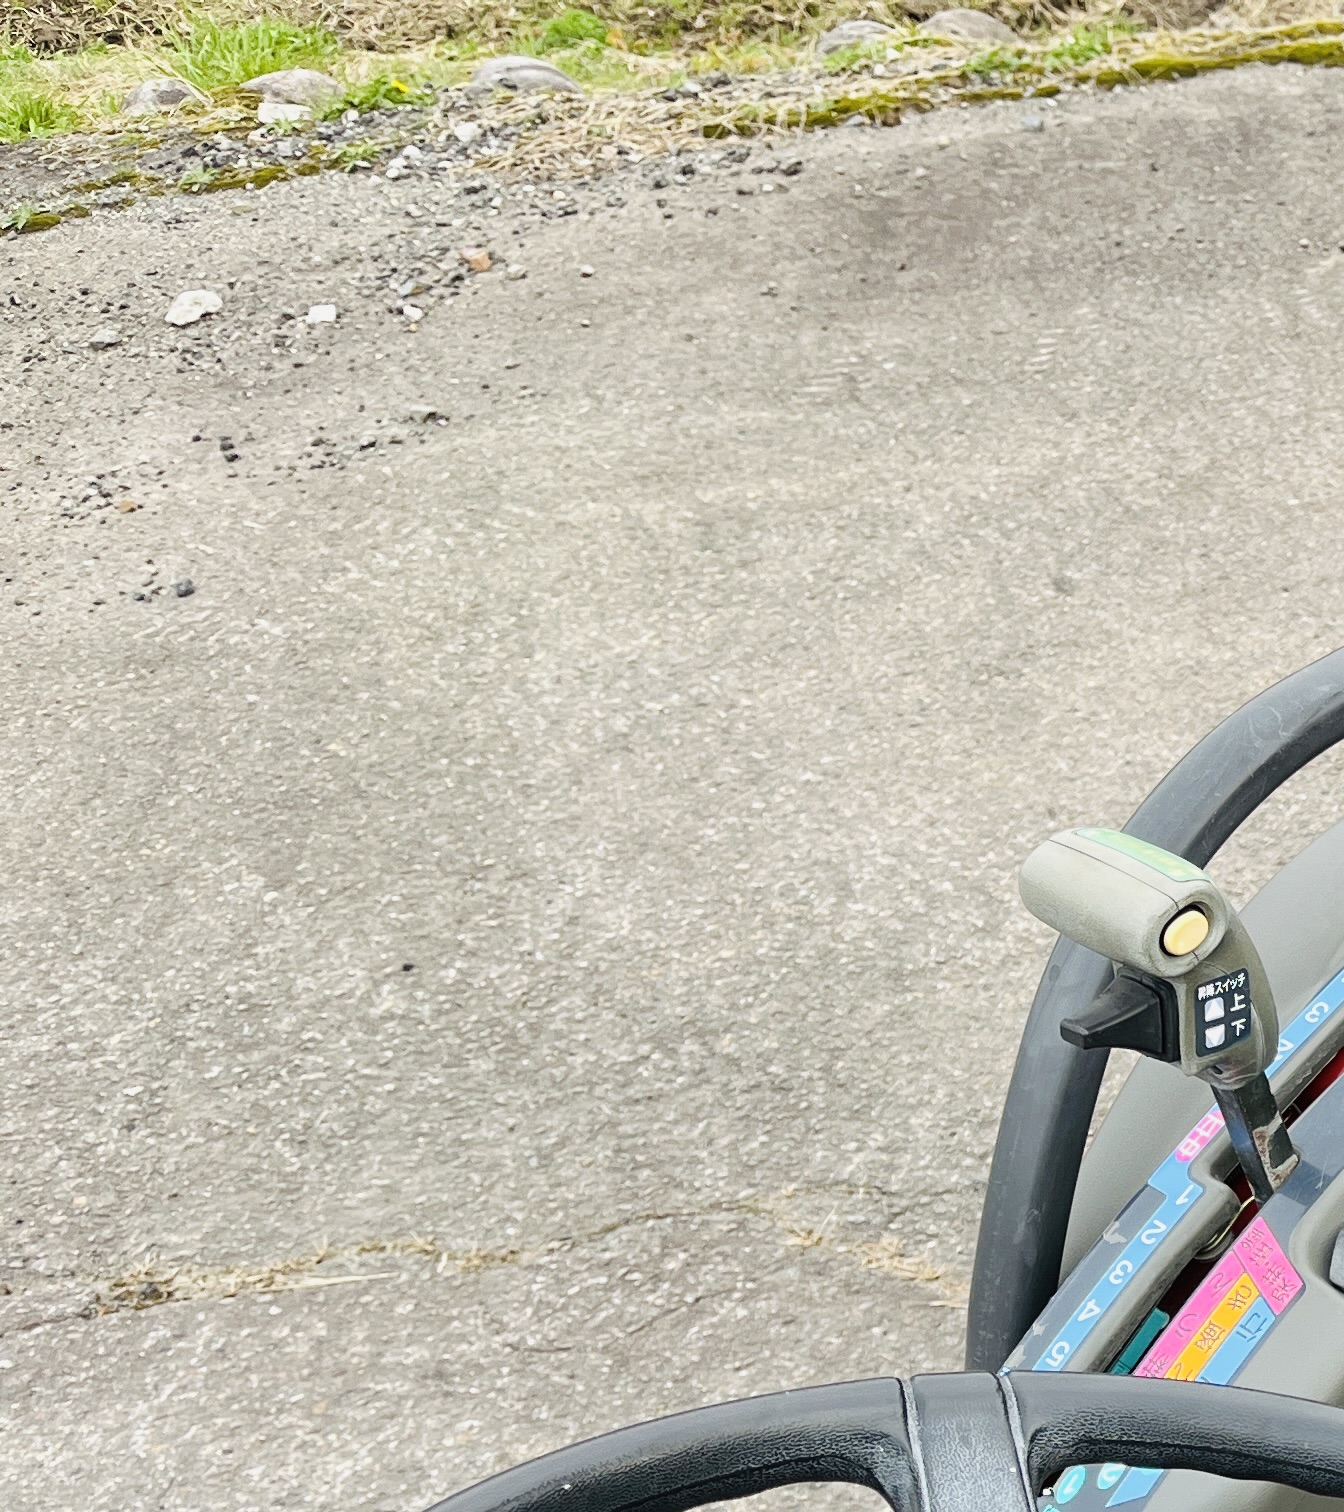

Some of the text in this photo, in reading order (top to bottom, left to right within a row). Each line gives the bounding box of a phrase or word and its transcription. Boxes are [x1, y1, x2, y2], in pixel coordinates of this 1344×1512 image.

[1229, 993, 1246, 1012] 上
[1303, 1000, 1329, 1023] 3
[1230, 1017, 1247, 1036] 下
[1175, 1184, 1199, 1206] 1
[1140, 1218, 1168, 1246] 2
[1107, 1259, 1134, 1285] 3
[1076, 1303, 1103, 1322] 4
[1044, 1340, 1071, 1368] 5
